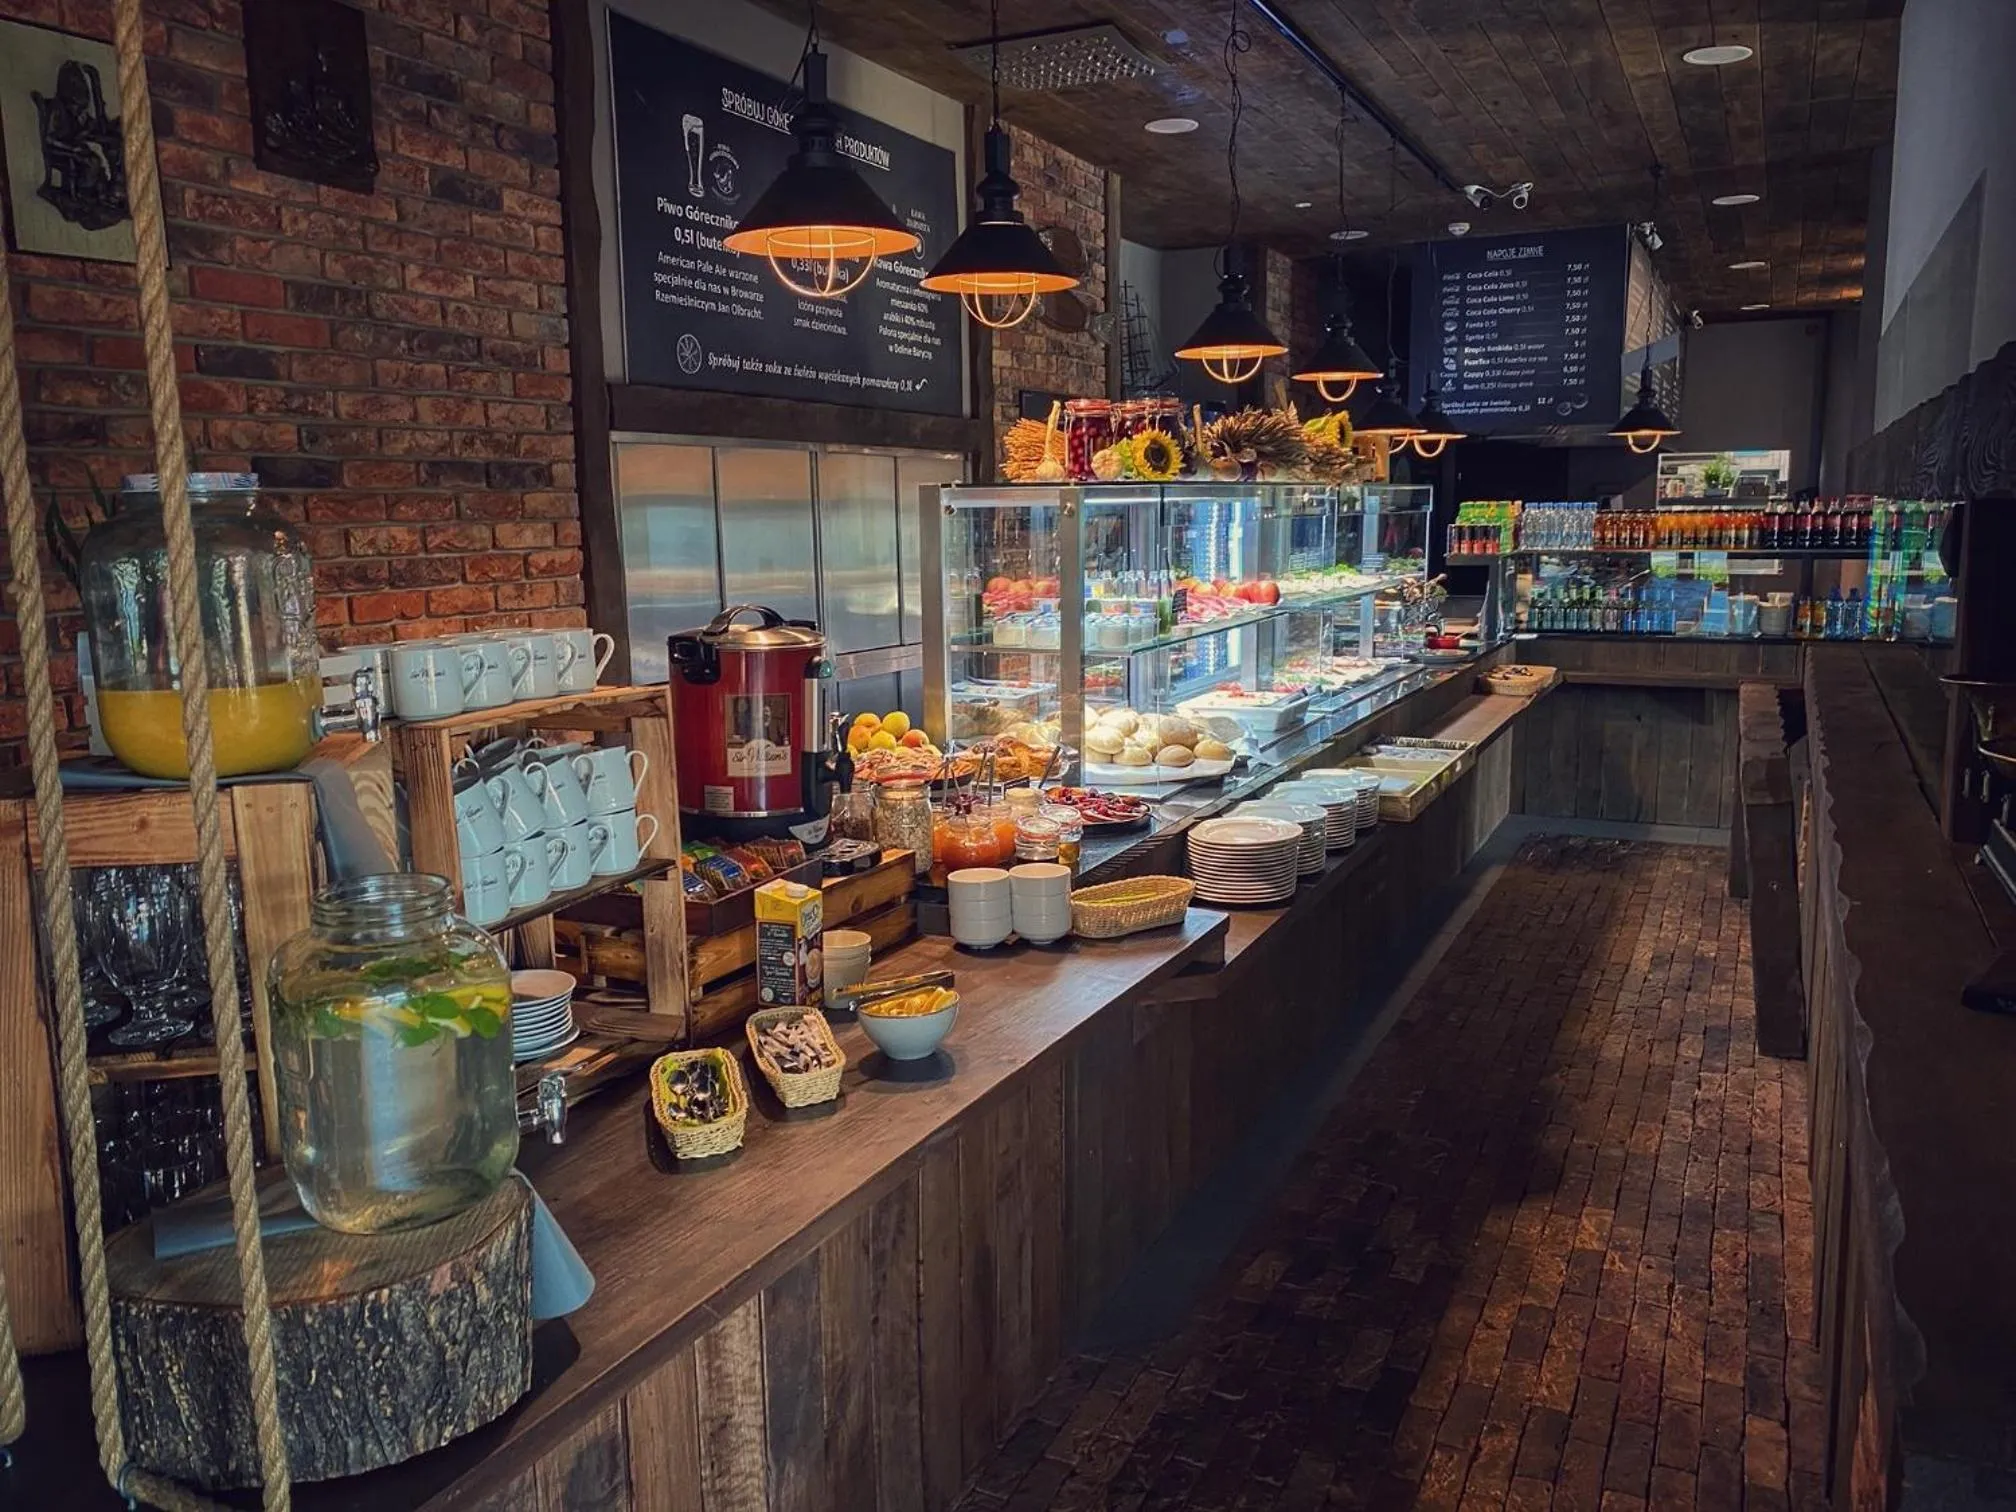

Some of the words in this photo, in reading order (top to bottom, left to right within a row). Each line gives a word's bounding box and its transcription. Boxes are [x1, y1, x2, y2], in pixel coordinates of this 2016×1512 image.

[721, 86, 765, 121] SPRÓBUJ
[844, 135, 891, 167] PRODUKTÓW
[656, 196, 683, 217] Piwo
[1487, 247, 1516, 260] NAPOJE
[658, 251, 696, 270] American
[697, 259, 713, 274] Pale
[714, 264, 727, 277] Ale
[728, 269, 759, 284] warzone
[653, 271, 693, 289] specjalnie
[694, 279, 706, 291] dla
[708, 283, 721, 294] nas
[722, 286, 730, 296] w
[731, 286, 764, 302] Browarze
[718, 301, 730, 313] Jan
[707, 352, 740, 372] Spróbuj
